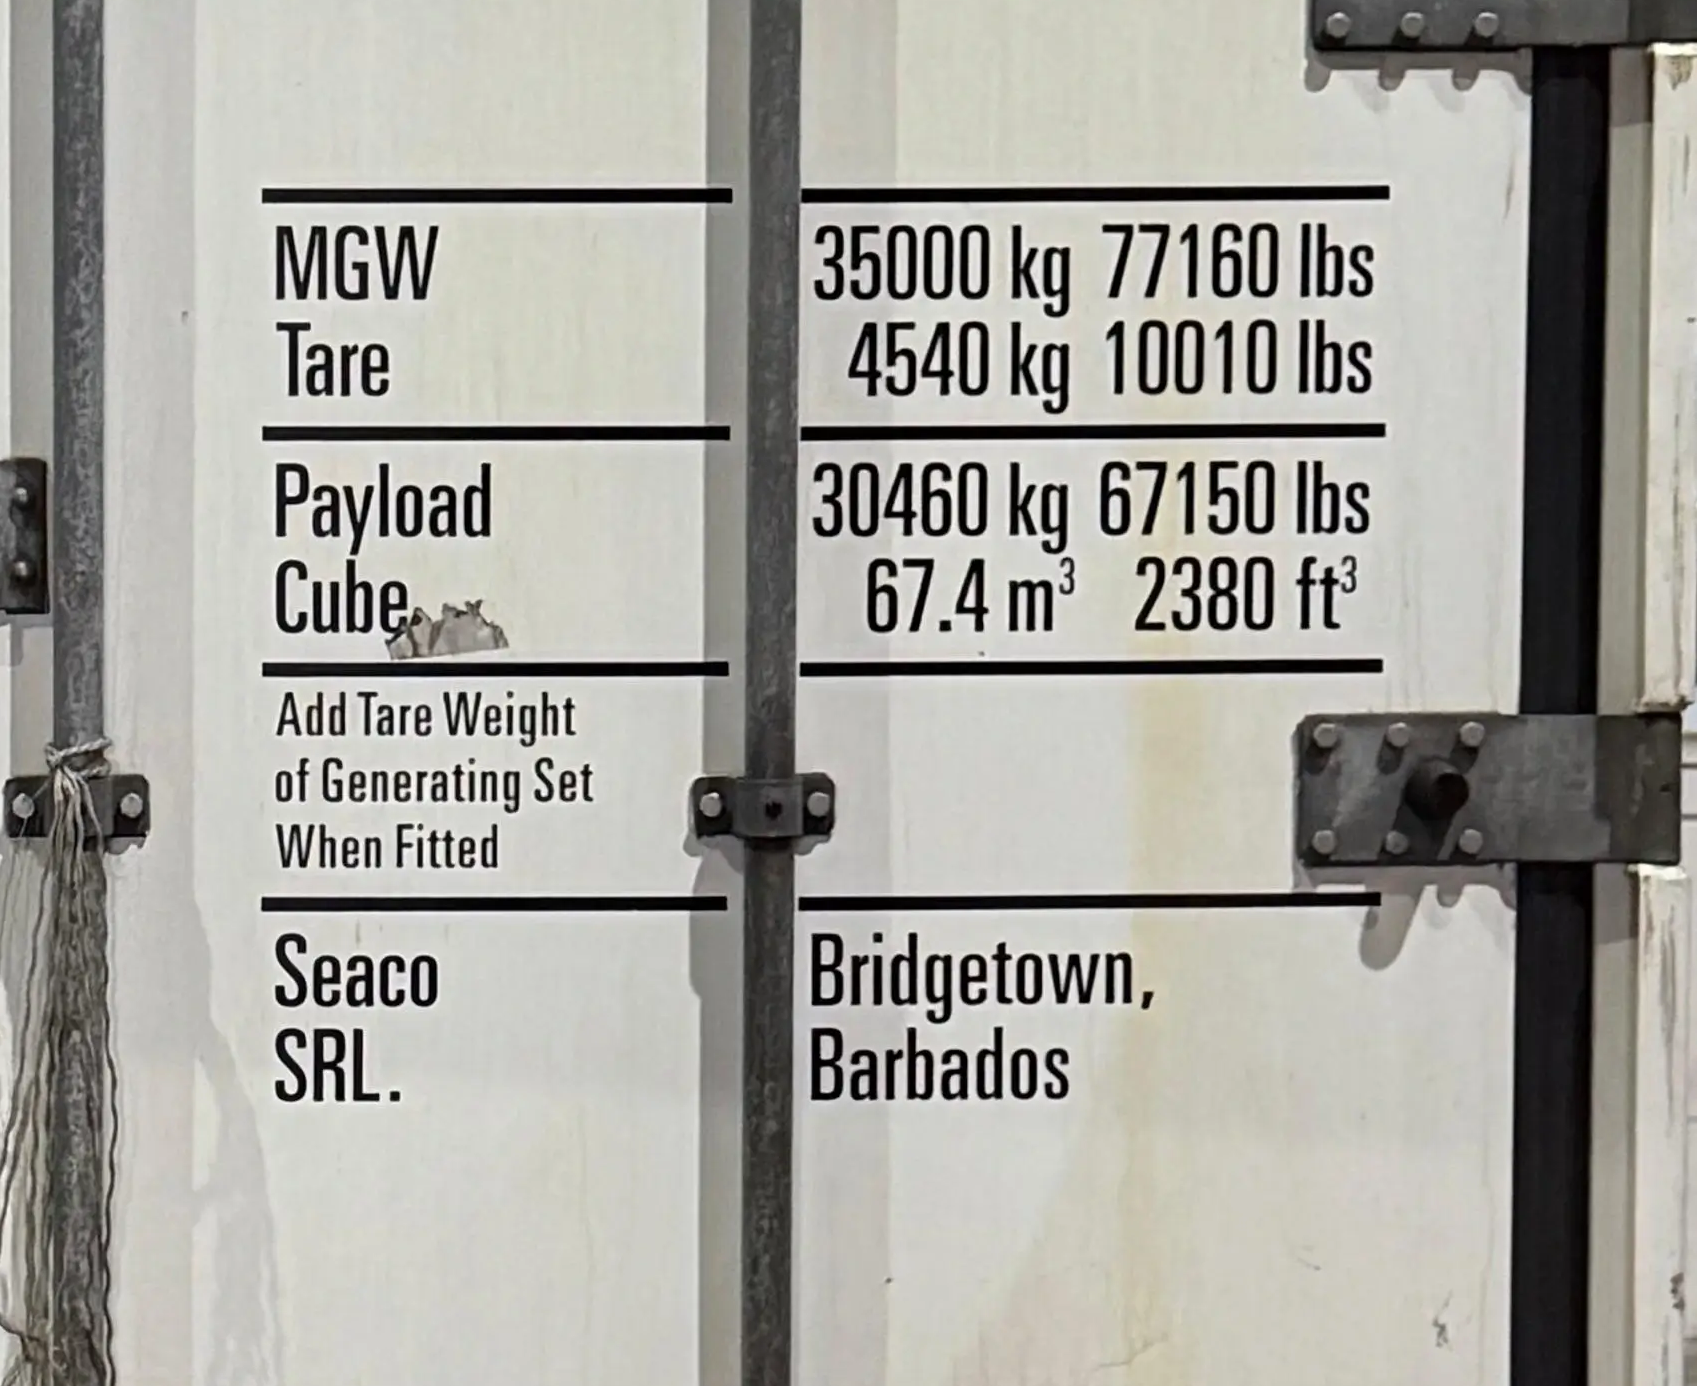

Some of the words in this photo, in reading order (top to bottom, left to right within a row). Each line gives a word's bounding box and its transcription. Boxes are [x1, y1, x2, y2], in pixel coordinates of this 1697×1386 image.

[277, 226, 438, 300] MGW
[815, 225, 989, 300] 35000
[1012, 225, 1070, 316] kg
[1103, 223, 1278, 298] 77160
[1301, 223, 1373, 297] lbs
[277, 323, 388, 396] Tare
[849, 322, 988, 396] 4540
[1011, 322, 1069, 414] kg
[1107, 320, 1276, 394] 10010
[1299, 320, 1371, 393] lbs
[277, 463, 490, 555] Payload
[813, 462, 987, 537] 30460
[1010, 463, 1068, 554] kg
[1101, 461, 1275, 535] 67150
[1297, 461, 1369, 533] lbs
[277, 560, 408, 634] Cube
[868, 559, 988, 633] 67.4
[1135, 557, 1274, 630] 2380
[277, 692, 346, 736] Add
[358, 692, 432, 736] Tare
[444, 692, 576, 747] Weight
[276, 758, 309, 803] of
[323, 758, 520, 813] Generating
[534, 758, 593, 803] Set
[276, 824, 382, 869] When
[397, 824, 498, 869] Fitted
[276, 934, 438, 1007] Seaco
[811, 933, 1154, 1024] Bridgetown,
[276, 1029, 401, 1102] SRL.
[811, 1027, 1069, 1101] Barbados
